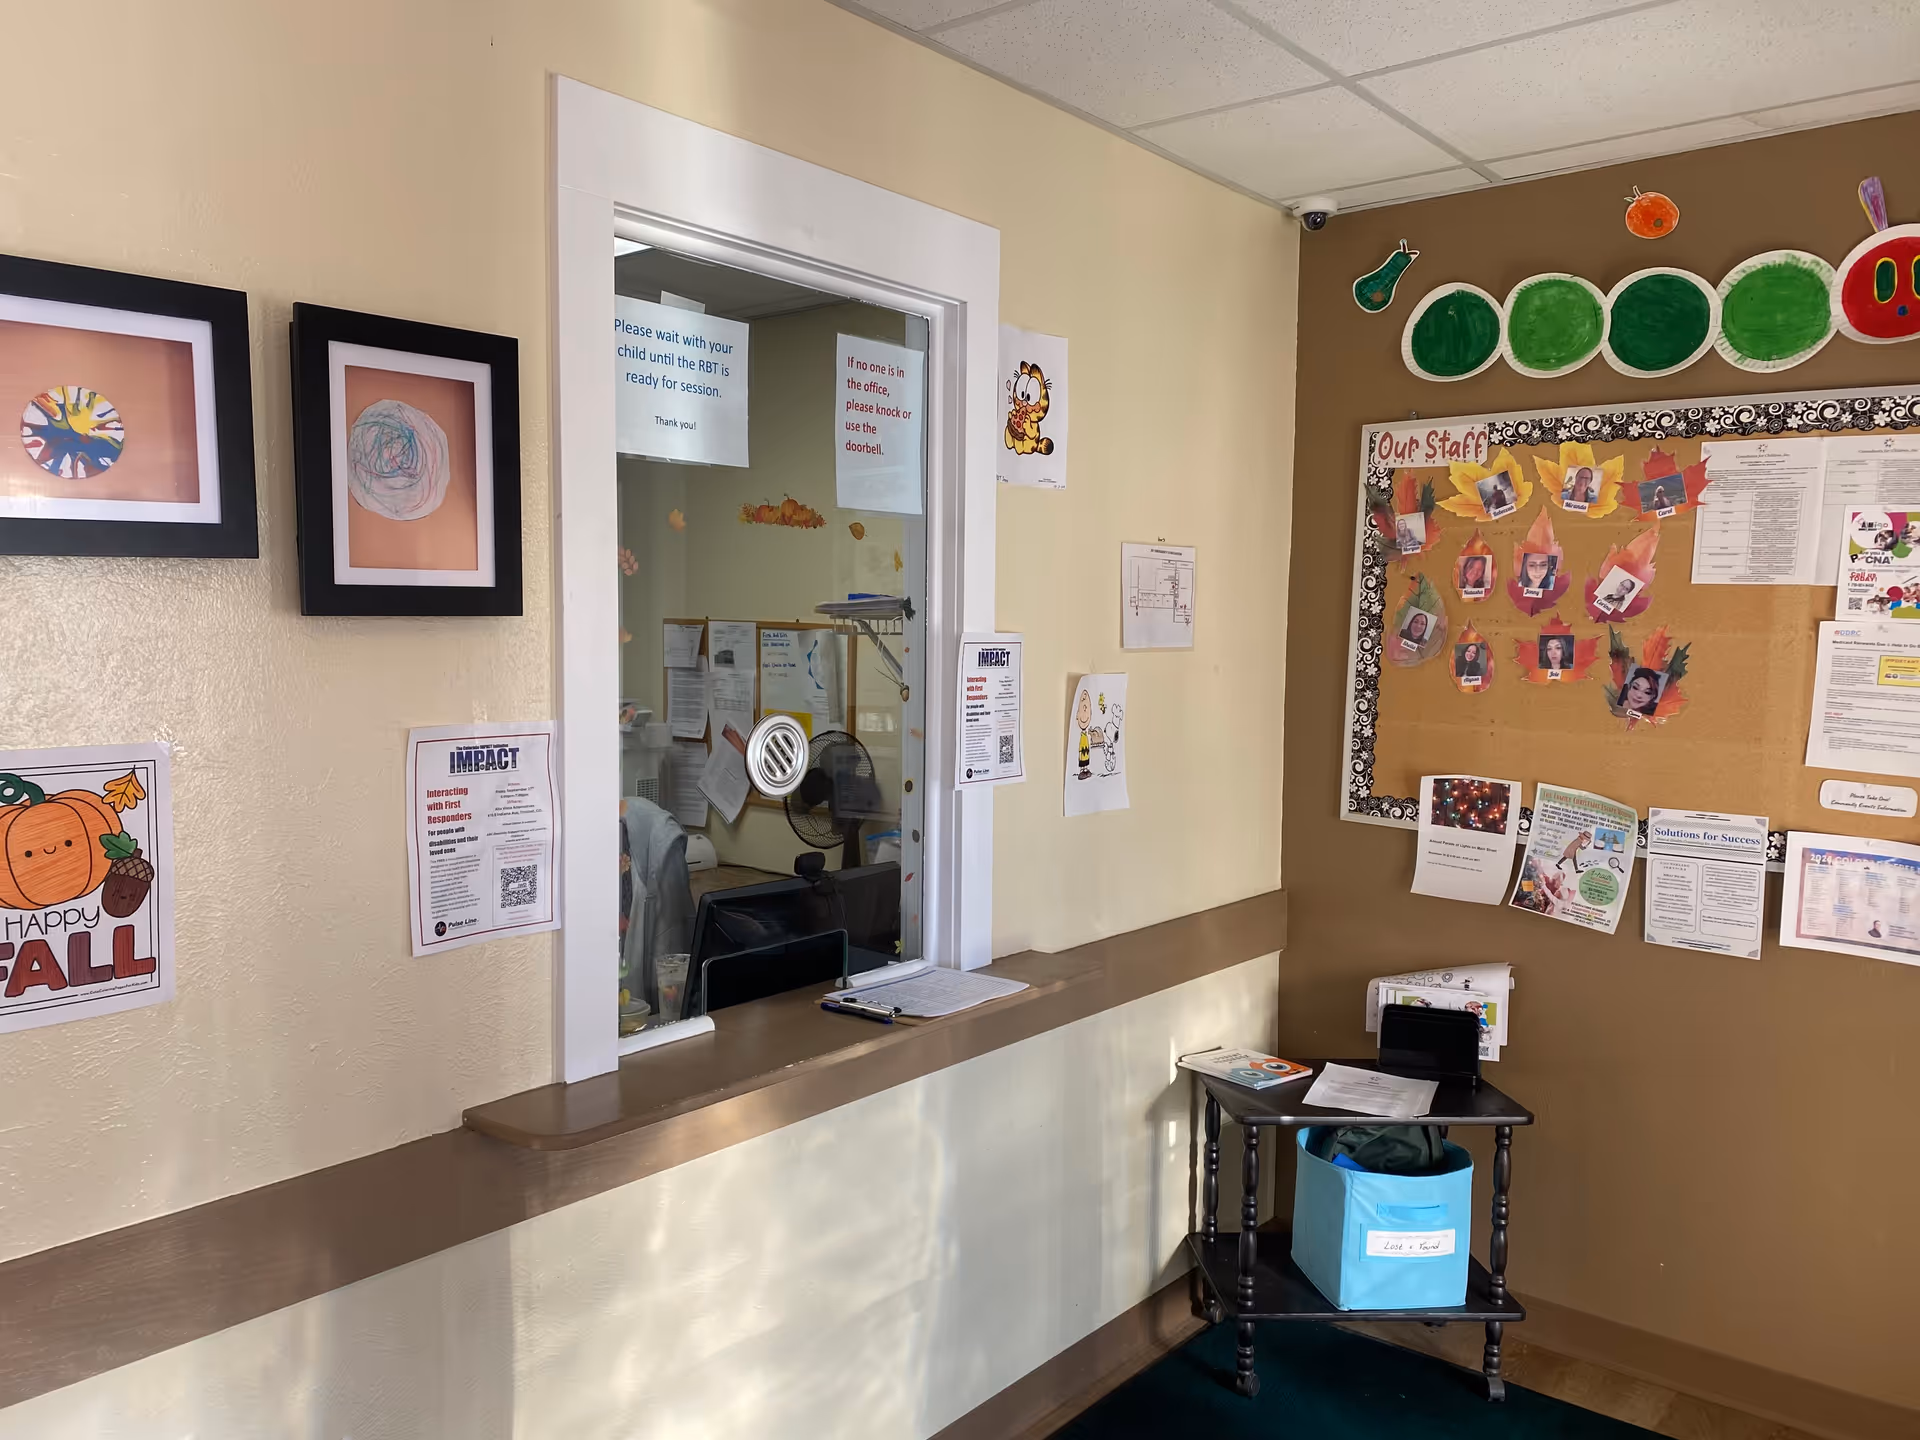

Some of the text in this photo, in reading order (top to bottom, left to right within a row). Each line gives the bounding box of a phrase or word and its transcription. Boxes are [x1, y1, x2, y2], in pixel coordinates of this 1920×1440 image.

[614, 319, 733, 354] Please wait with your
[617, 344, 730, 376] child until the RBT is
[847, 356, 905, 378] If no one is in
[626, 372, 722, 398] ready for session.
[847, 377, 890, 397] the office,
[846, 399, 911, 419] please knock or
[655, 415, 697, 430] Thank you!
[845, 421, 877, 434] use the
[845, 440, 884, 455] doorbell.
[1378, 430, 1487, 460] Our Staff
[1565, 502, 1587, 510] Miranda
[1658, 508, 1673, 517] Carol
[1525, 589, 1539, 597] Jenny
[978, 651, 1010, 667] IMPACT
[449, 747, 519, 773] IMPACT
[427, 787, 468, 798] Interacting
[427, 800, 461, 811] with First
[427, 813, 472, 824] Responders
[437, 828, 454, 836] people
[1654, 827, 1761, 845] Solutions for Success
[429, 839, 456, 847] disabilities
[1810, 854, 1833, 864] 2024
[1384, 1241, 1440, 1250] Lost Found
